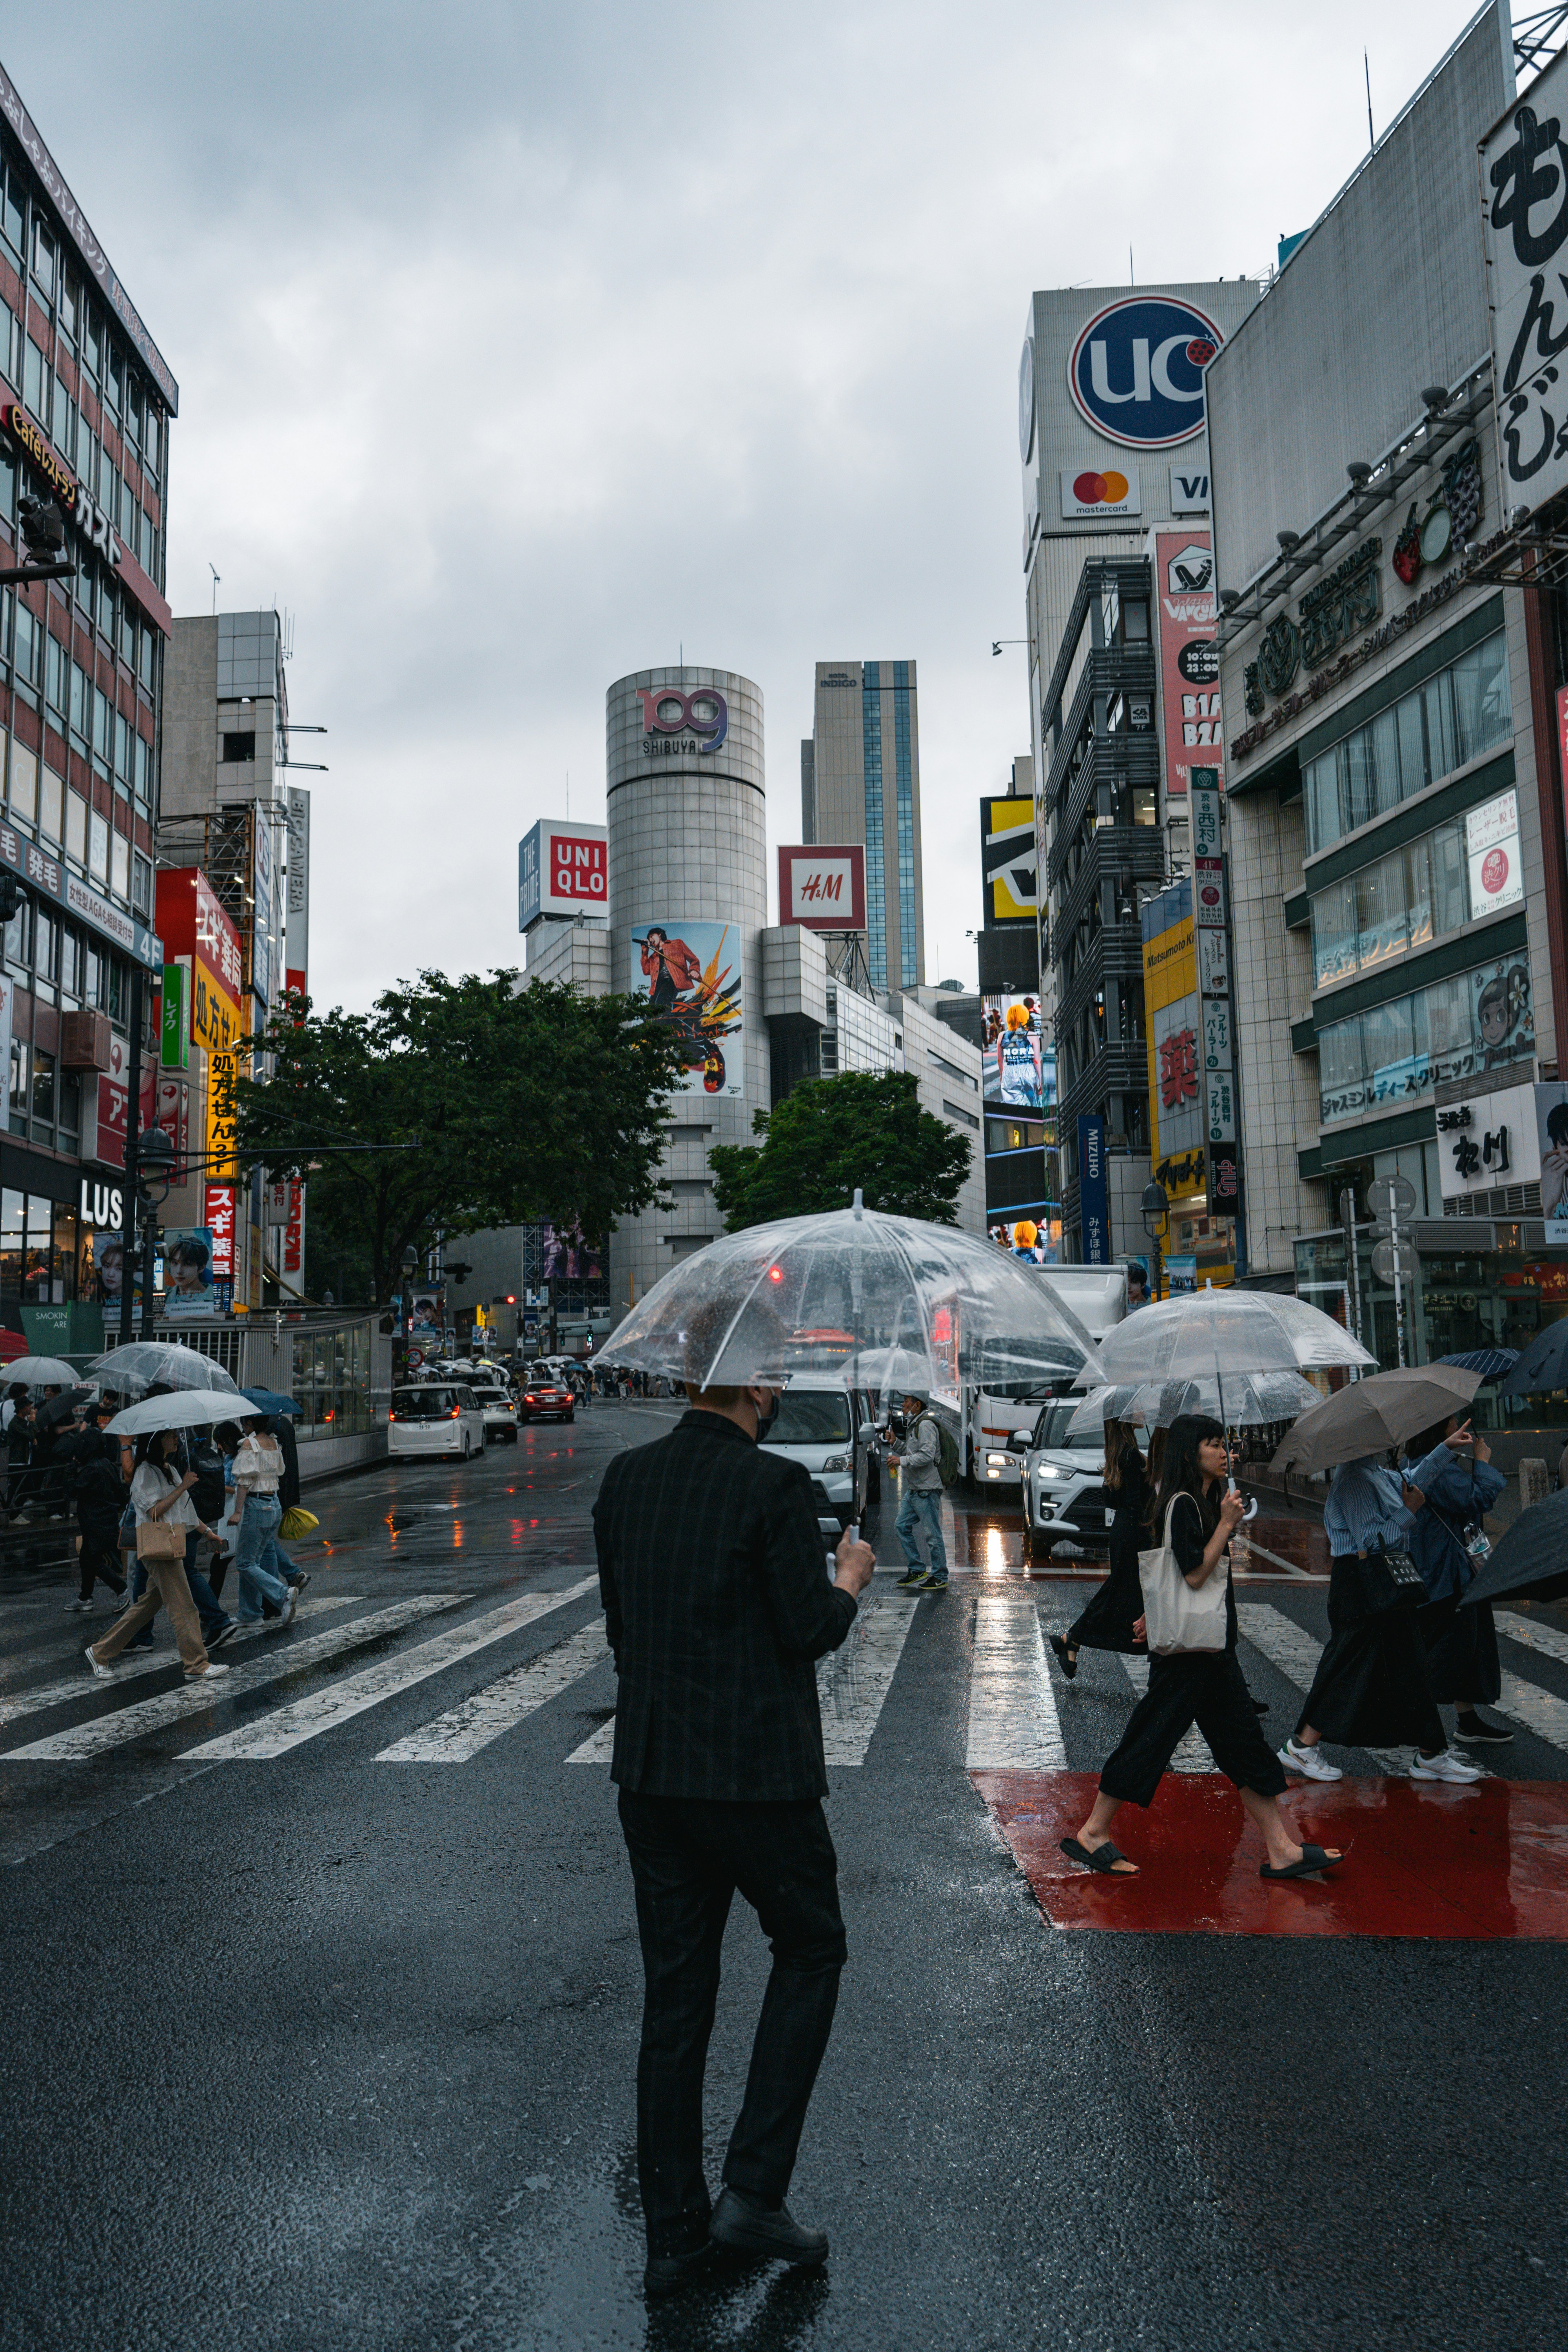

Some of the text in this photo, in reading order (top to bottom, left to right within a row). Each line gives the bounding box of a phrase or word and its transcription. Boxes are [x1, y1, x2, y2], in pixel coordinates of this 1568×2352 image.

[1076, 505, 1127, 514] mastercard
[76, 488, 122, 572] ガスト
[636, 689, 728, 752] 109
[643, 740, 696, 754] SHIBUYA
[1198, 792, 1216, 843] 渋谷西村
[1468, 793, 1514, 824] カウンセリング無料
[1469, 806, 1515, 839] レーザー脱毛
[523, 838, 536, 866] THE
[557, 844, 600, 869] UNI
[1203, 860, 1215, 869] 4F
[29, 848, 58, 893] 発毛
[290, 835, 304, 913] CAMERA
[557, 869, 604, 894] QLO
[800, 873, 844, 902] H&M
[519, 869, 540, 918] PRIME
[69, 884, 133, 944] 女性型AGAも相談受付中
[140, 933, 160, 967] 4F
[1147, 942, 1185, 969] Matsumoto
[165, 998, 176, 1030] レイク
[196, 973, 236, 1048] 処方せ
[1207, 1019, 1216, 1054] パーラー
[1218, 1014, 1227, 1049] フルーツ
[1003, 1047, 1034, 1055] NORA
[1159, 1029, 1198, 1108] 薬
[1210, 1091, 1220, 1126] フルーツ
[1221, 1085, 1231, 1123] 渋谷西村
[1088, 1129, 1099, 1178] MIZUHO
[1217, 1160, 1237, 1196] HUB
[208, 1189, 233, 1275] スギ薬局
[53, 1320, 67, 1328] ARE
